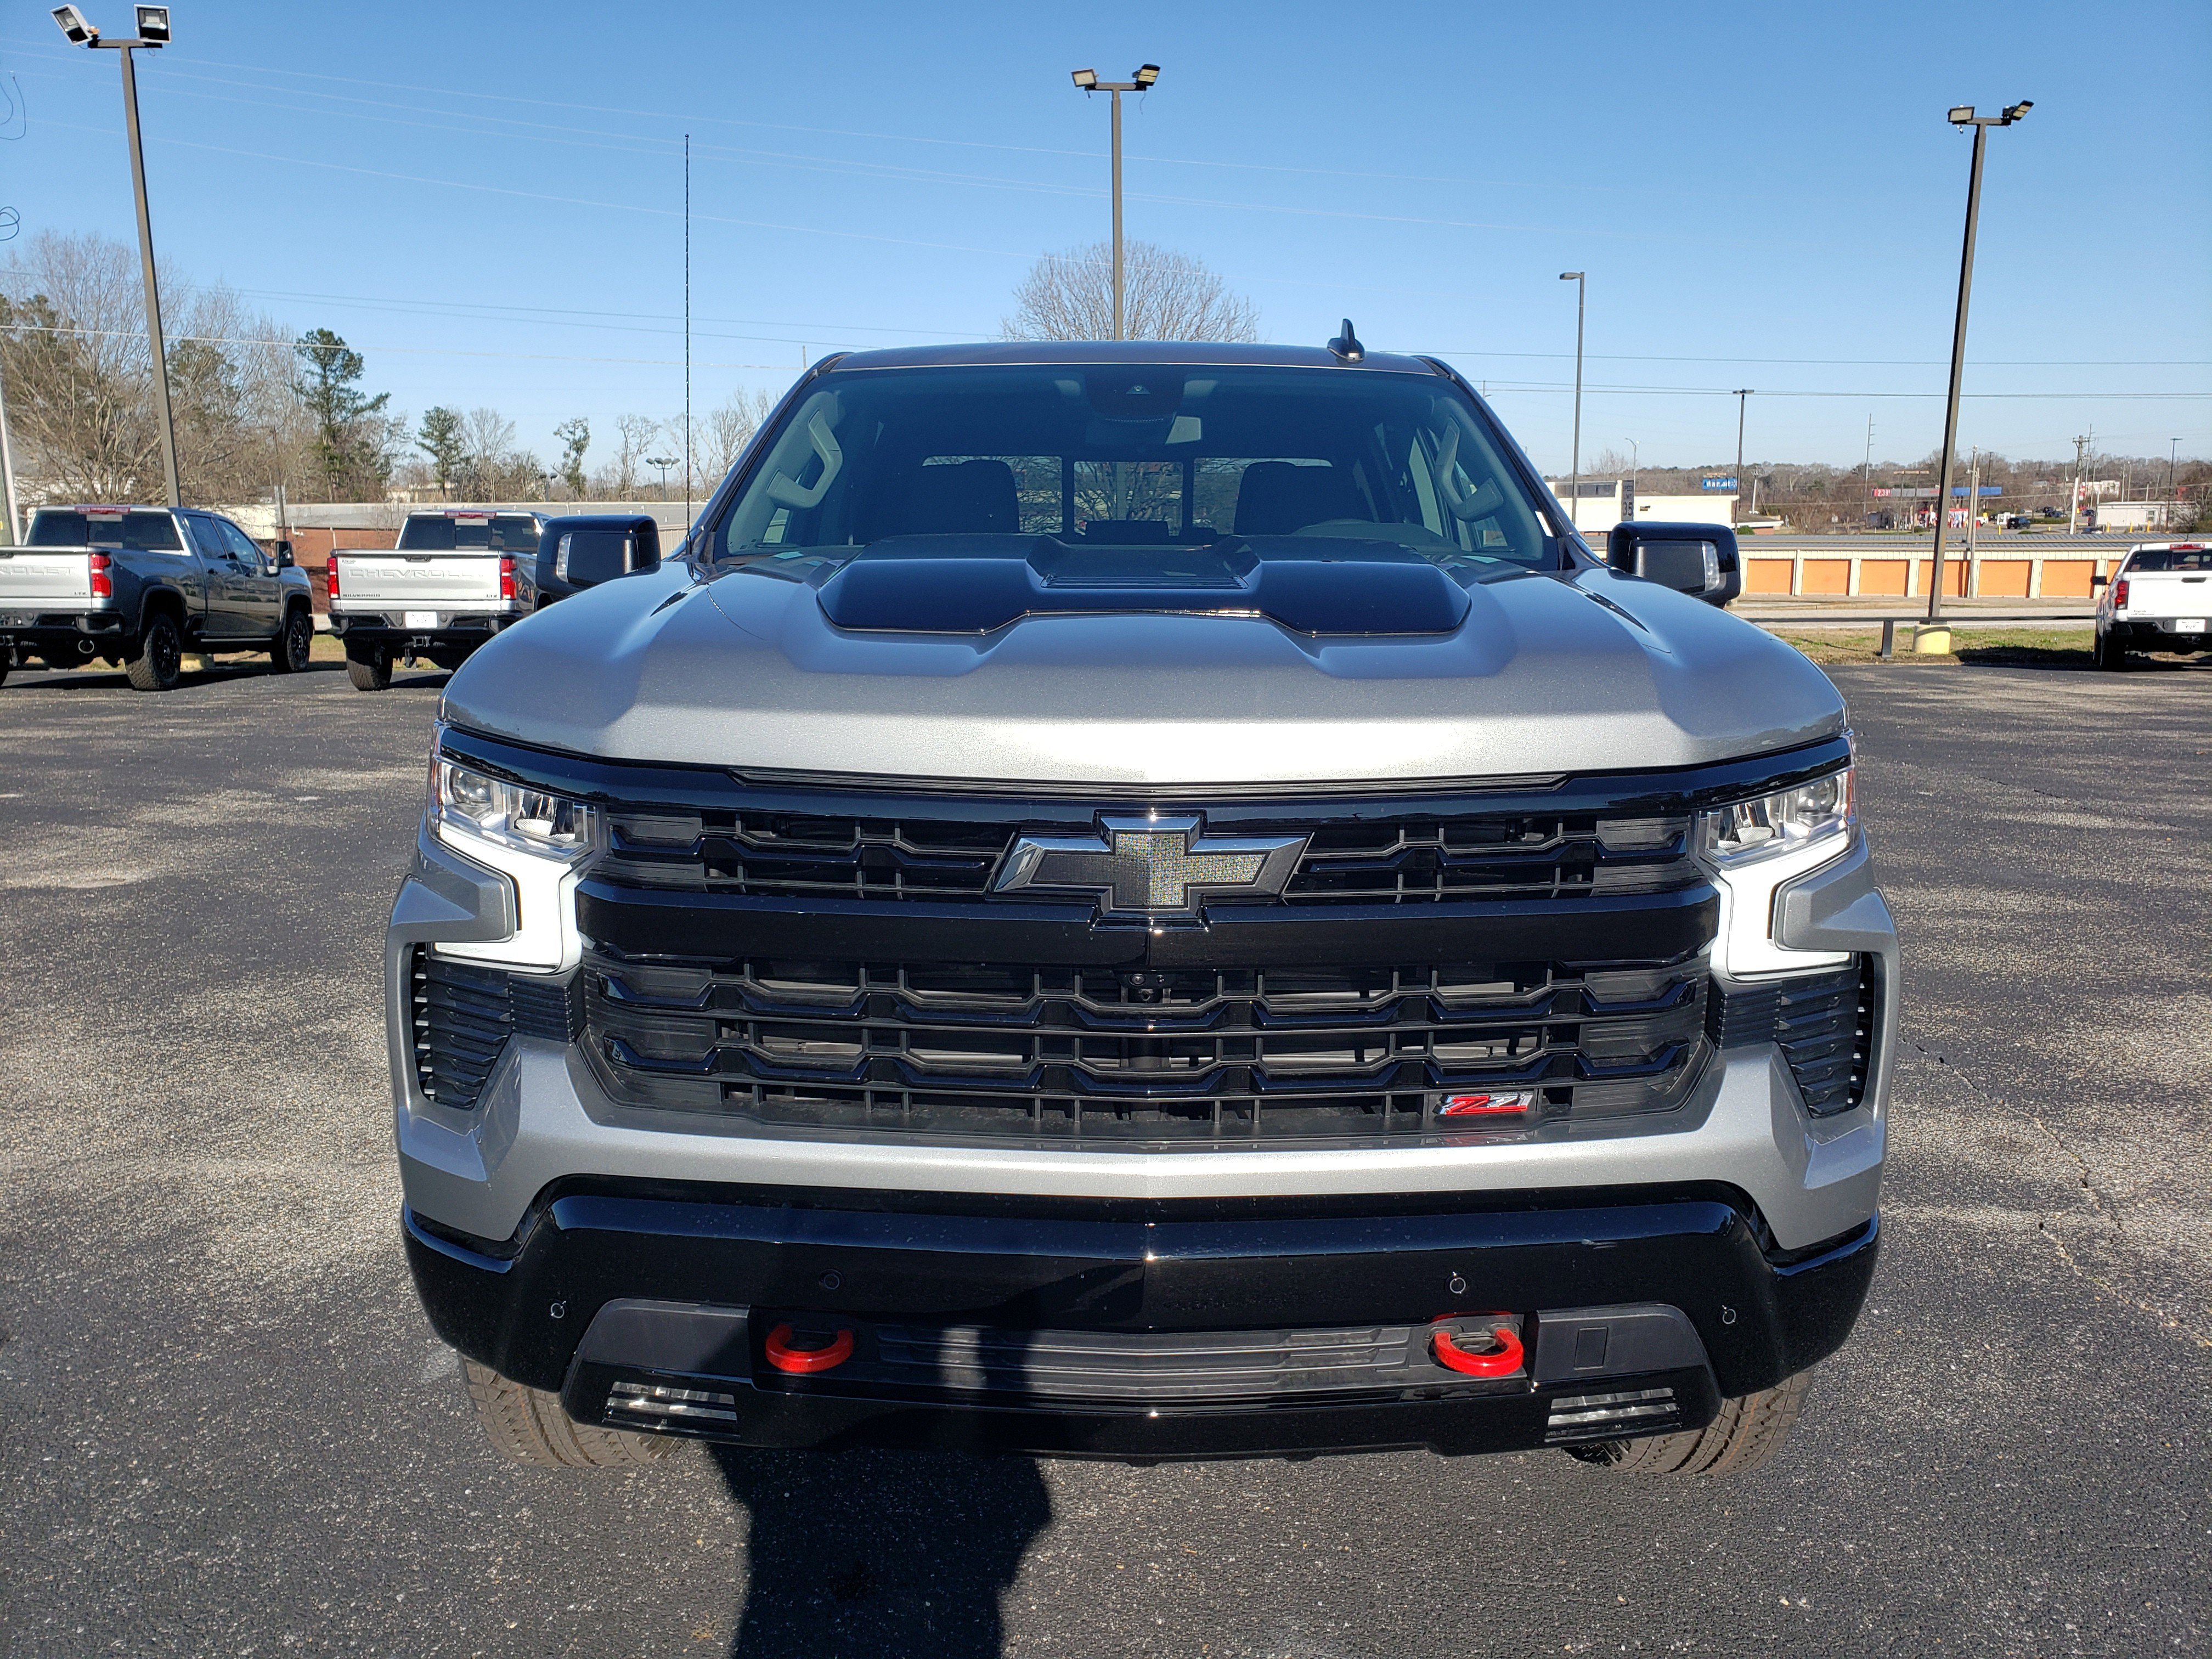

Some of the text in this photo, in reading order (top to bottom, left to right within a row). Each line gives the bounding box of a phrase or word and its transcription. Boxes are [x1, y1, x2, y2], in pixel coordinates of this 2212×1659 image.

[1623, 501, 1633, 516] 35
[348, 568, 486, 579] CHEVROL
[1436, 1092, 1534, 1115] Z71
